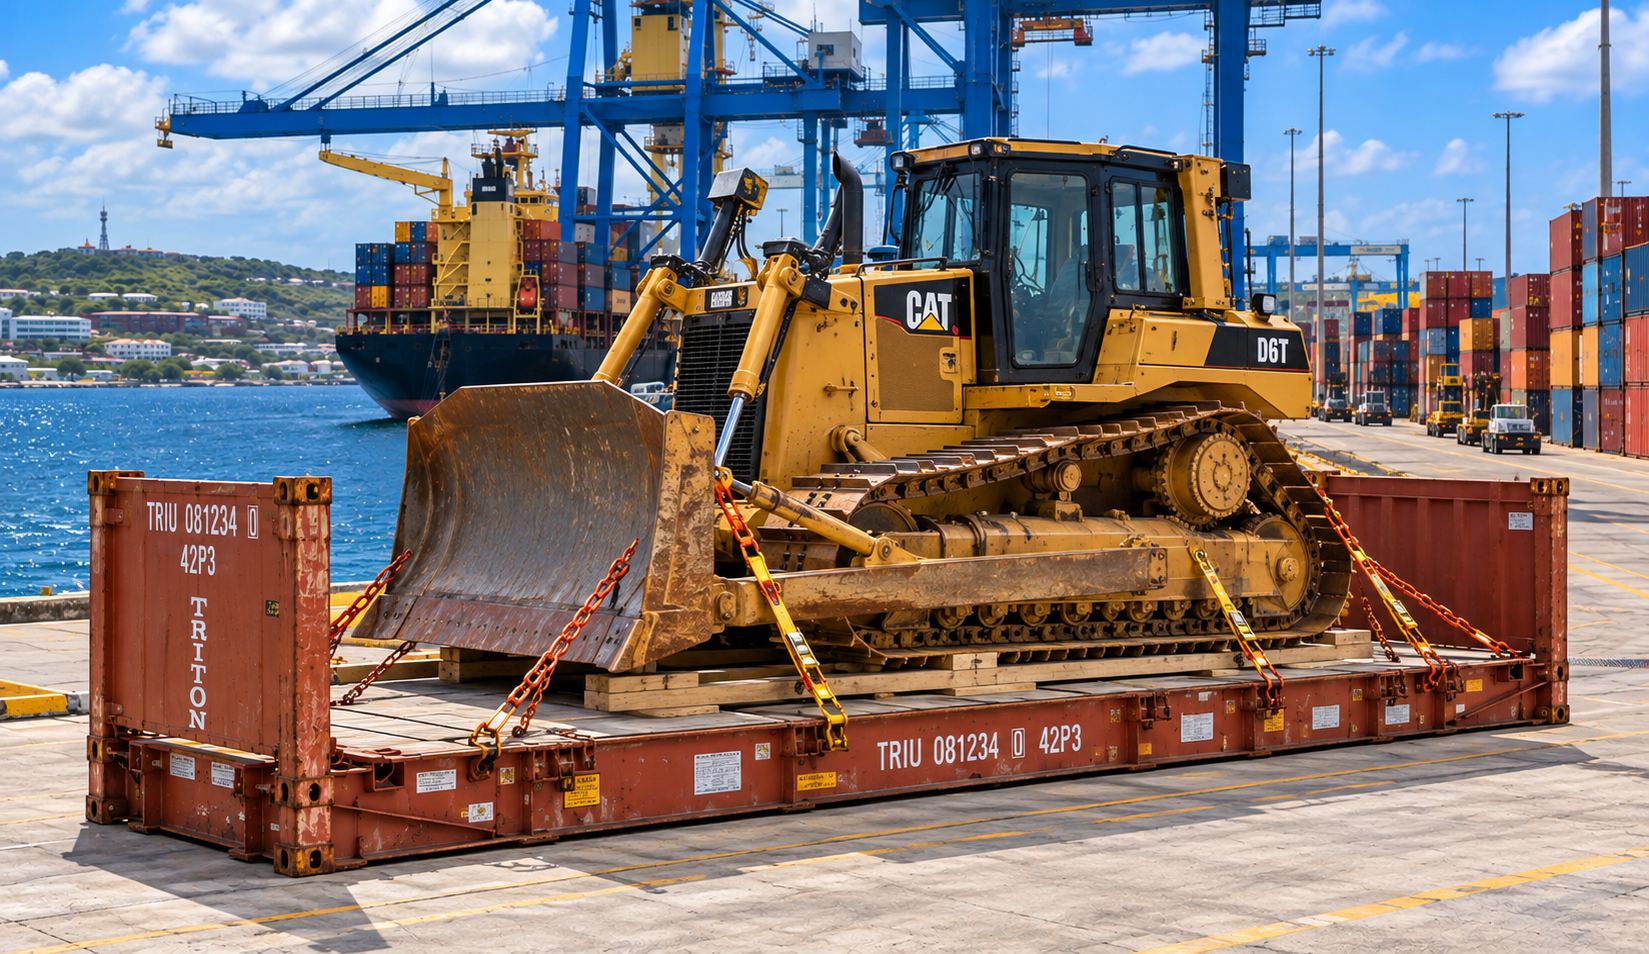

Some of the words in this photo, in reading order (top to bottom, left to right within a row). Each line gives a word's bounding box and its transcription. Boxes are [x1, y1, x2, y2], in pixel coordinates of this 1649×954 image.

[906, 290, 952, 330] CAT
[1257, 337, 1289, 364] D6T
[147, 502, 177, 532] TRIU
[185, 504, 237, 536] 081234
[180, 544, 216, 576] 42P3
[188, 596, 208, 730] TRITON
[877, 737, 922, 771] TRIU
[934, 731, 999, 765] 081234
[1038, 723, 1082, 755] 42P3
